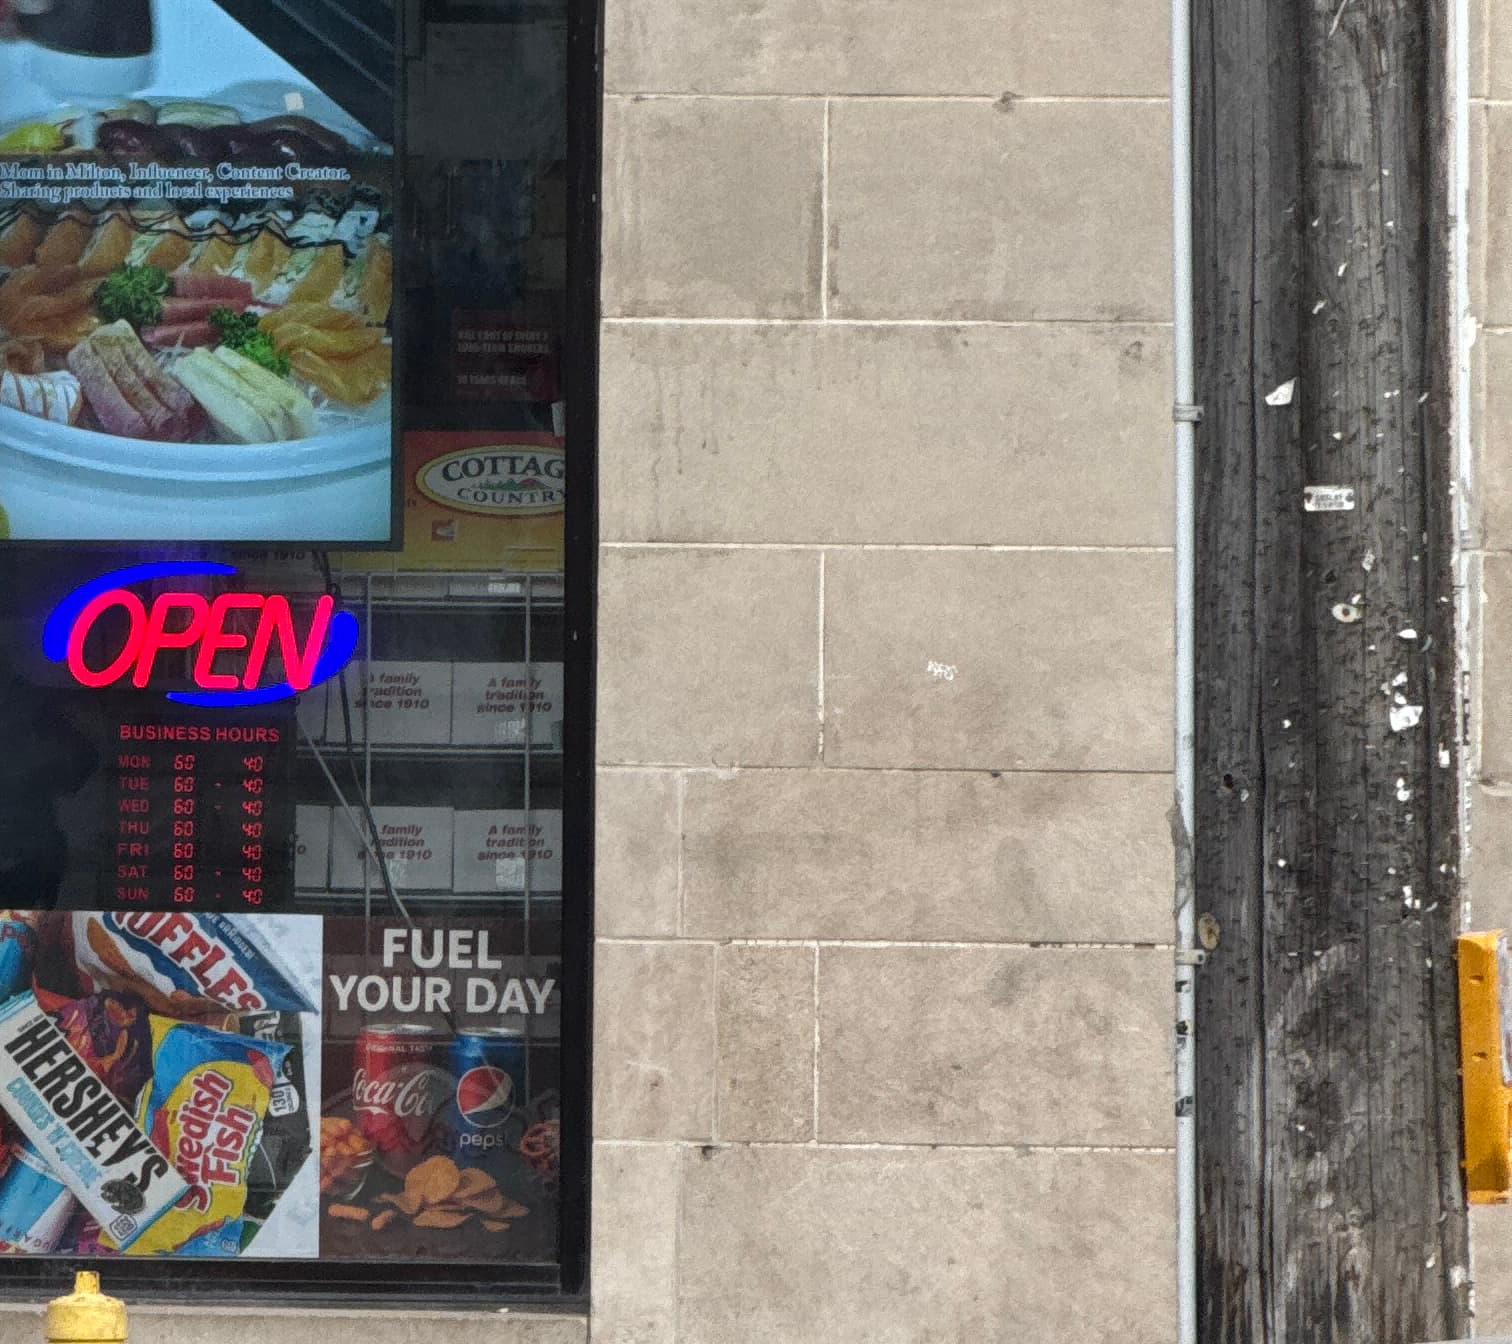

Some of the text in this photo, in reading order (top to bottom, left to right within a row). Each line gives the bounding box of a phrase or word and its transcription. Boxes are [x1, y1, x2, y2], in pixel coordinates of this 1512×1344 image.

[0, 162, 351, 183] Mom in Milton, Influencer, Content Creator.
[0, 181, 294, 204] Sharing products and local experiences
[441, 455, 564, 482] COTTAG
[67, 588, 334, 690] OPEN
[379, 672, 421, 686] family
[488, 677, 497, 688] A
[368, 686, 422, 698] radition
[354, 698, 430, 710] sce 1910
[477, 703, 515, 715] since
[119, 724, 280, 743] BUSINESS HOURS
[118, 754, 152, 768] MON
[119, 776, 150, 790] TUE
[119, 799, 150, 812] WED
[119, 821, 149, 835] THU
[380, 824, 423, 837] family
[488, 825, 497, 836] A
[117, 843, 149, 856] FRI
[370, 837, 424, 848] adition
[486, 837, 544, 848] traditon
[399, 849, 432, 861] 1910
[477, 850, 515, 861] since
[117, 864, 148, 878] SAT
[117, 887, 149, 901] SUN
[382, 928, 503, 970] FUEL
[110, 912, 262, 1014] UFFLES
[329, 974, 556, 1014] YOUR DAY
[4, 1019, 169, 1193] HERSHEY'S
[273, 1088, 286, 1113] 130
[175, 1070, 232, 1213] Swedish
[200, 1104, 255, 1184] Fish
[459, 1132, 508, 1150] peps
